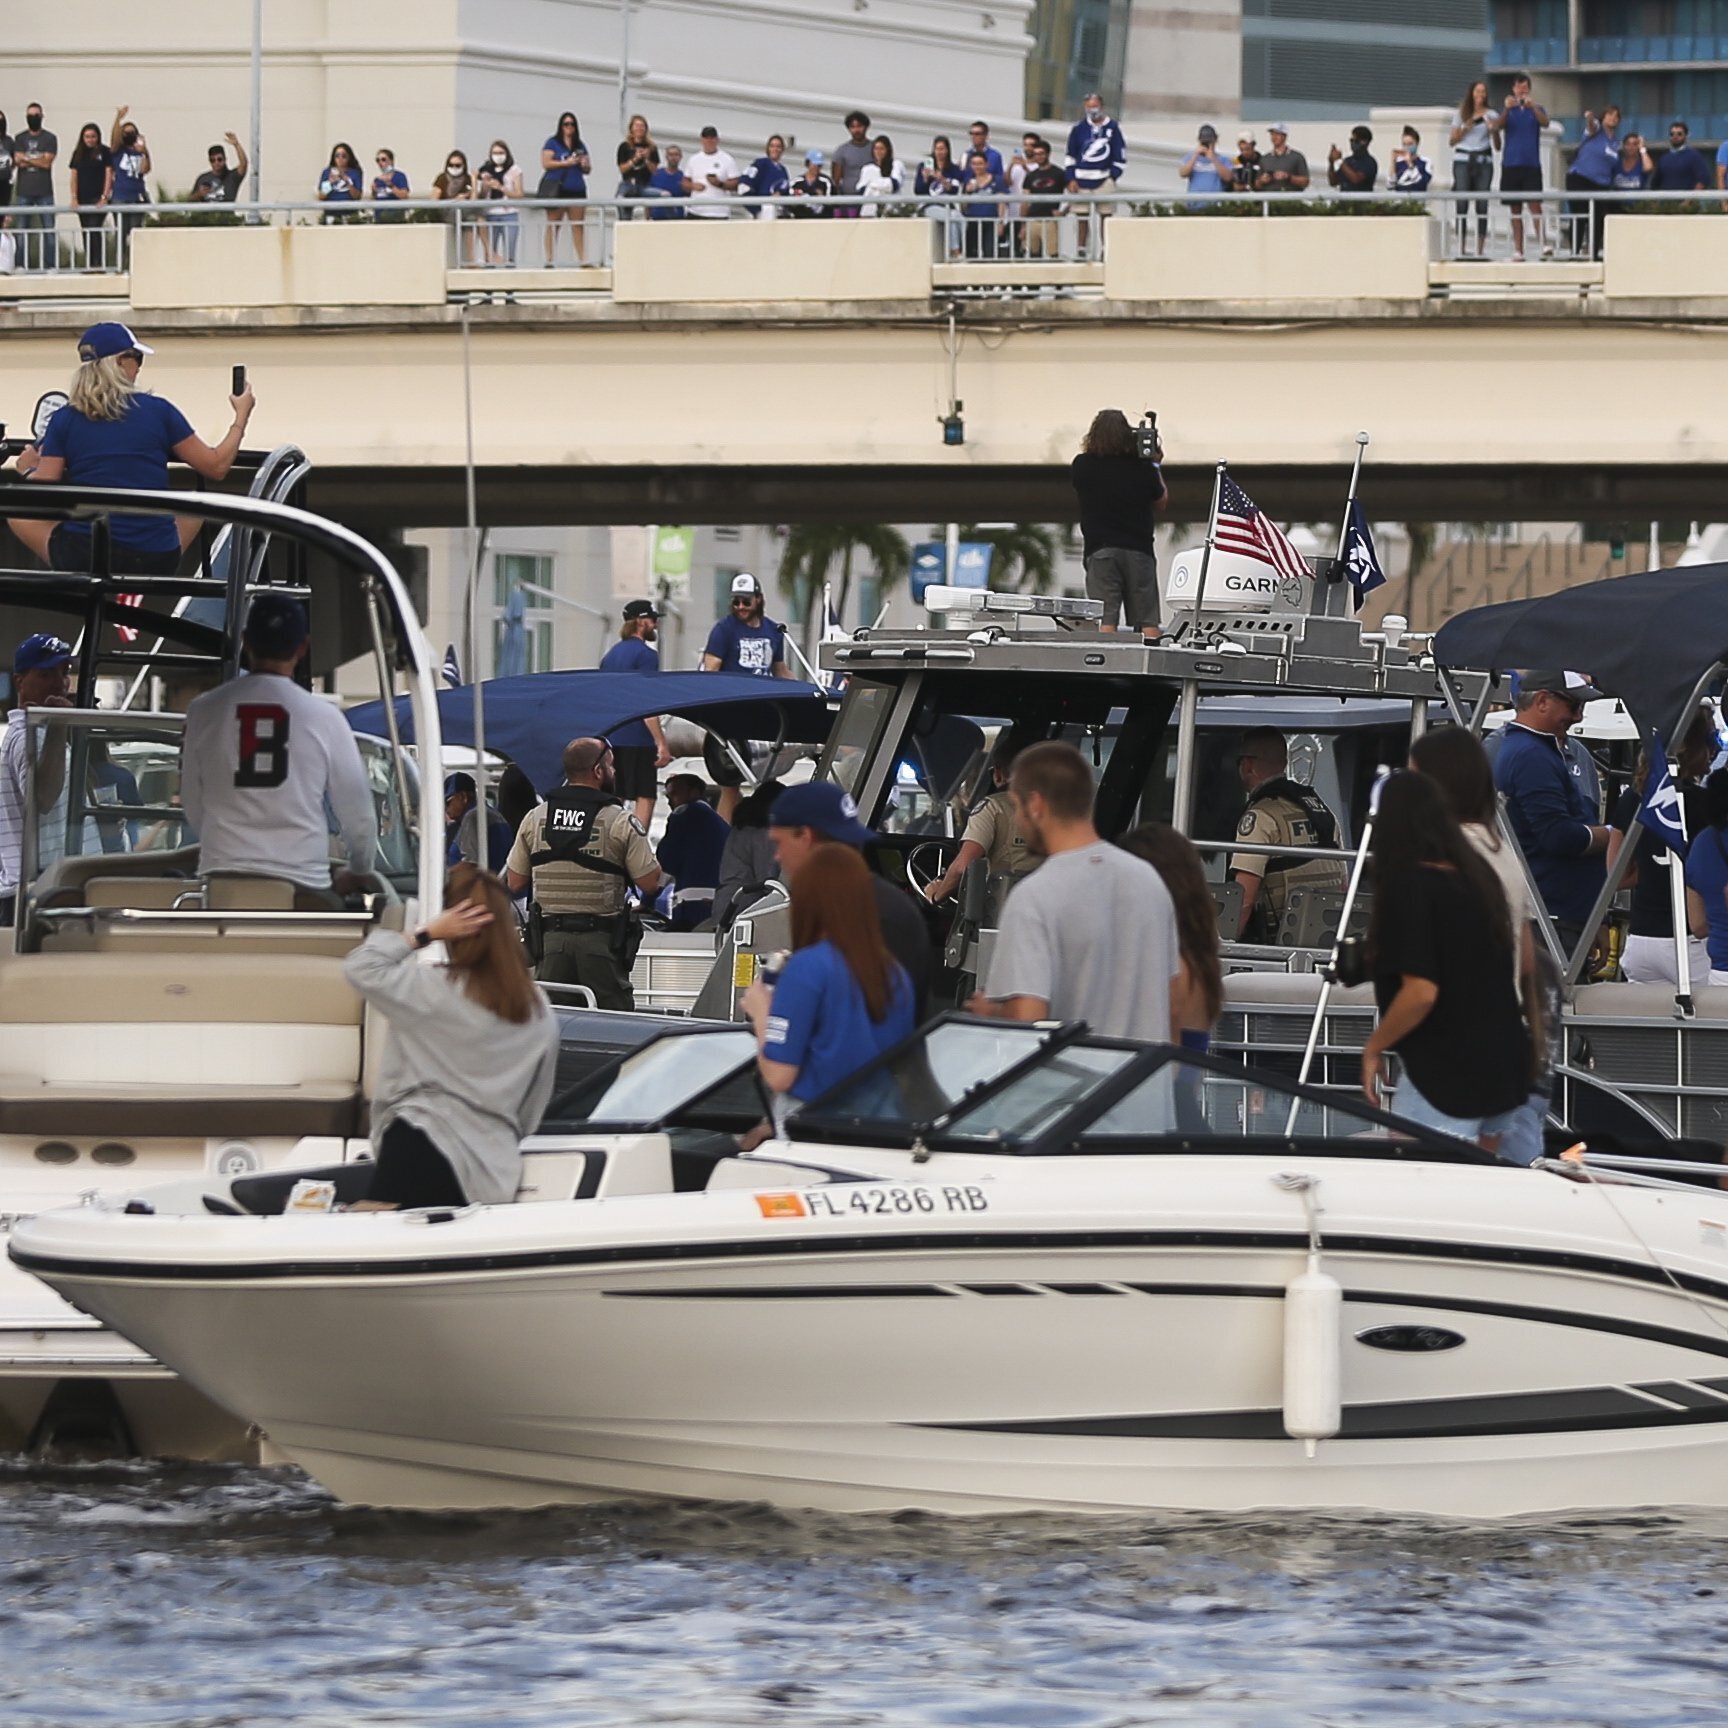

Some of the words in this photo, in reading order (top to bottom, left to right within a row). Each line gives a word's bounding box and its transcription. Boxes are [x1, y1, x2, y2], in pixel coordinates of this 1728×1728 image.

[234, 704, 290, 788] B
[553, 809, 586, 827] FWC
[805, 1192, 845, 1216] FL
[850, 1188, 934, 1215] 4286
[942, 1186, 988, 1212] RB
